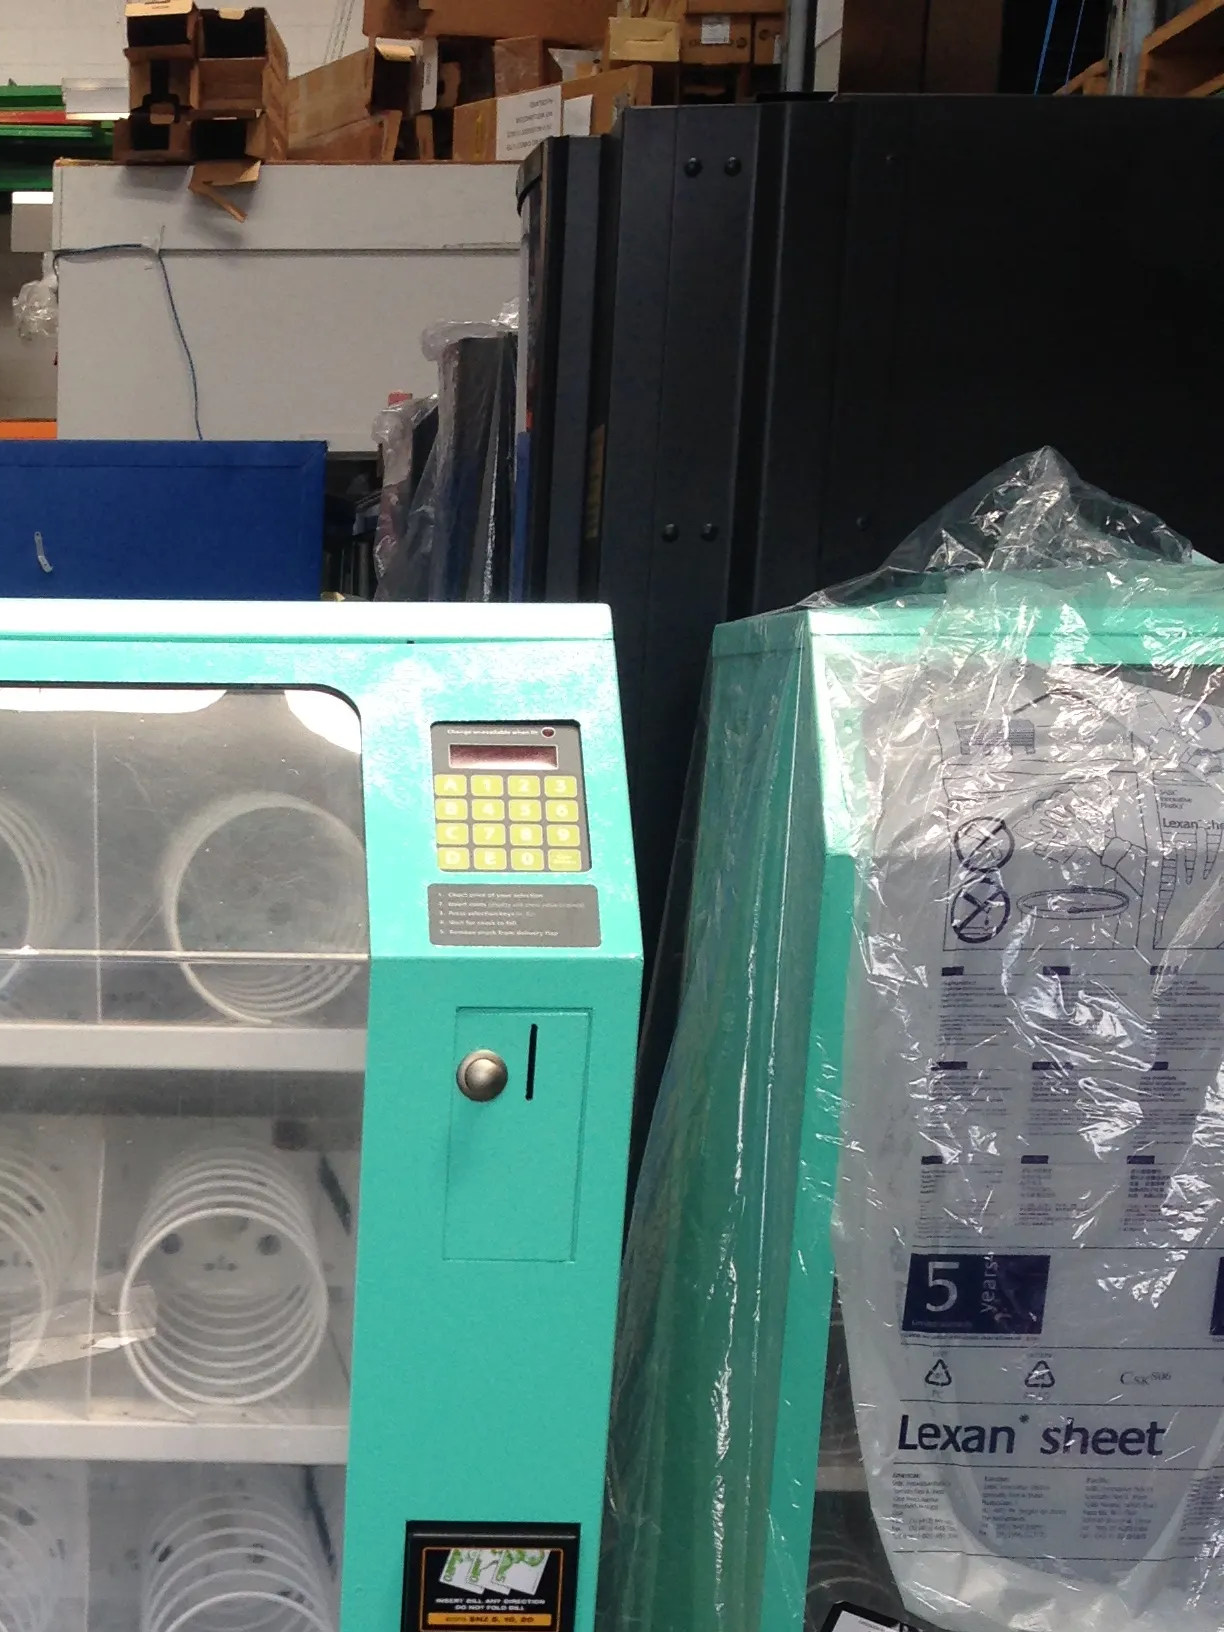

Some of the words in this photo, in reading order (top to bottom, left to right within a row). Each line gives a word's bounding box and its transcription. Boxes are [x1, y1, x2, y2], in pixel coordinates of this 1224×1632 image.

[443, 779, 458, 793] A
[482, 780, 490, 792] 1
[519, 780, 530, 793] 2
[554, 780, 566, 793] 3
[445, 802, 457, 816] B
[482, 803, 495, 816] 4
[519, 803, 531, 817] 5
[556, 804, 568, 817] 6
[445, 826, 459, 840] C
[483, 827, 495, 840] 7
[520, 827, 533, 841] 8
[557, 828, 570, 841] 9
[445, 850, 461, 865] D
[484, 851, 497, 865] E
[926, 1262, 960, 1312] 5
[1039, 1417, 1166, 1455] sheet
